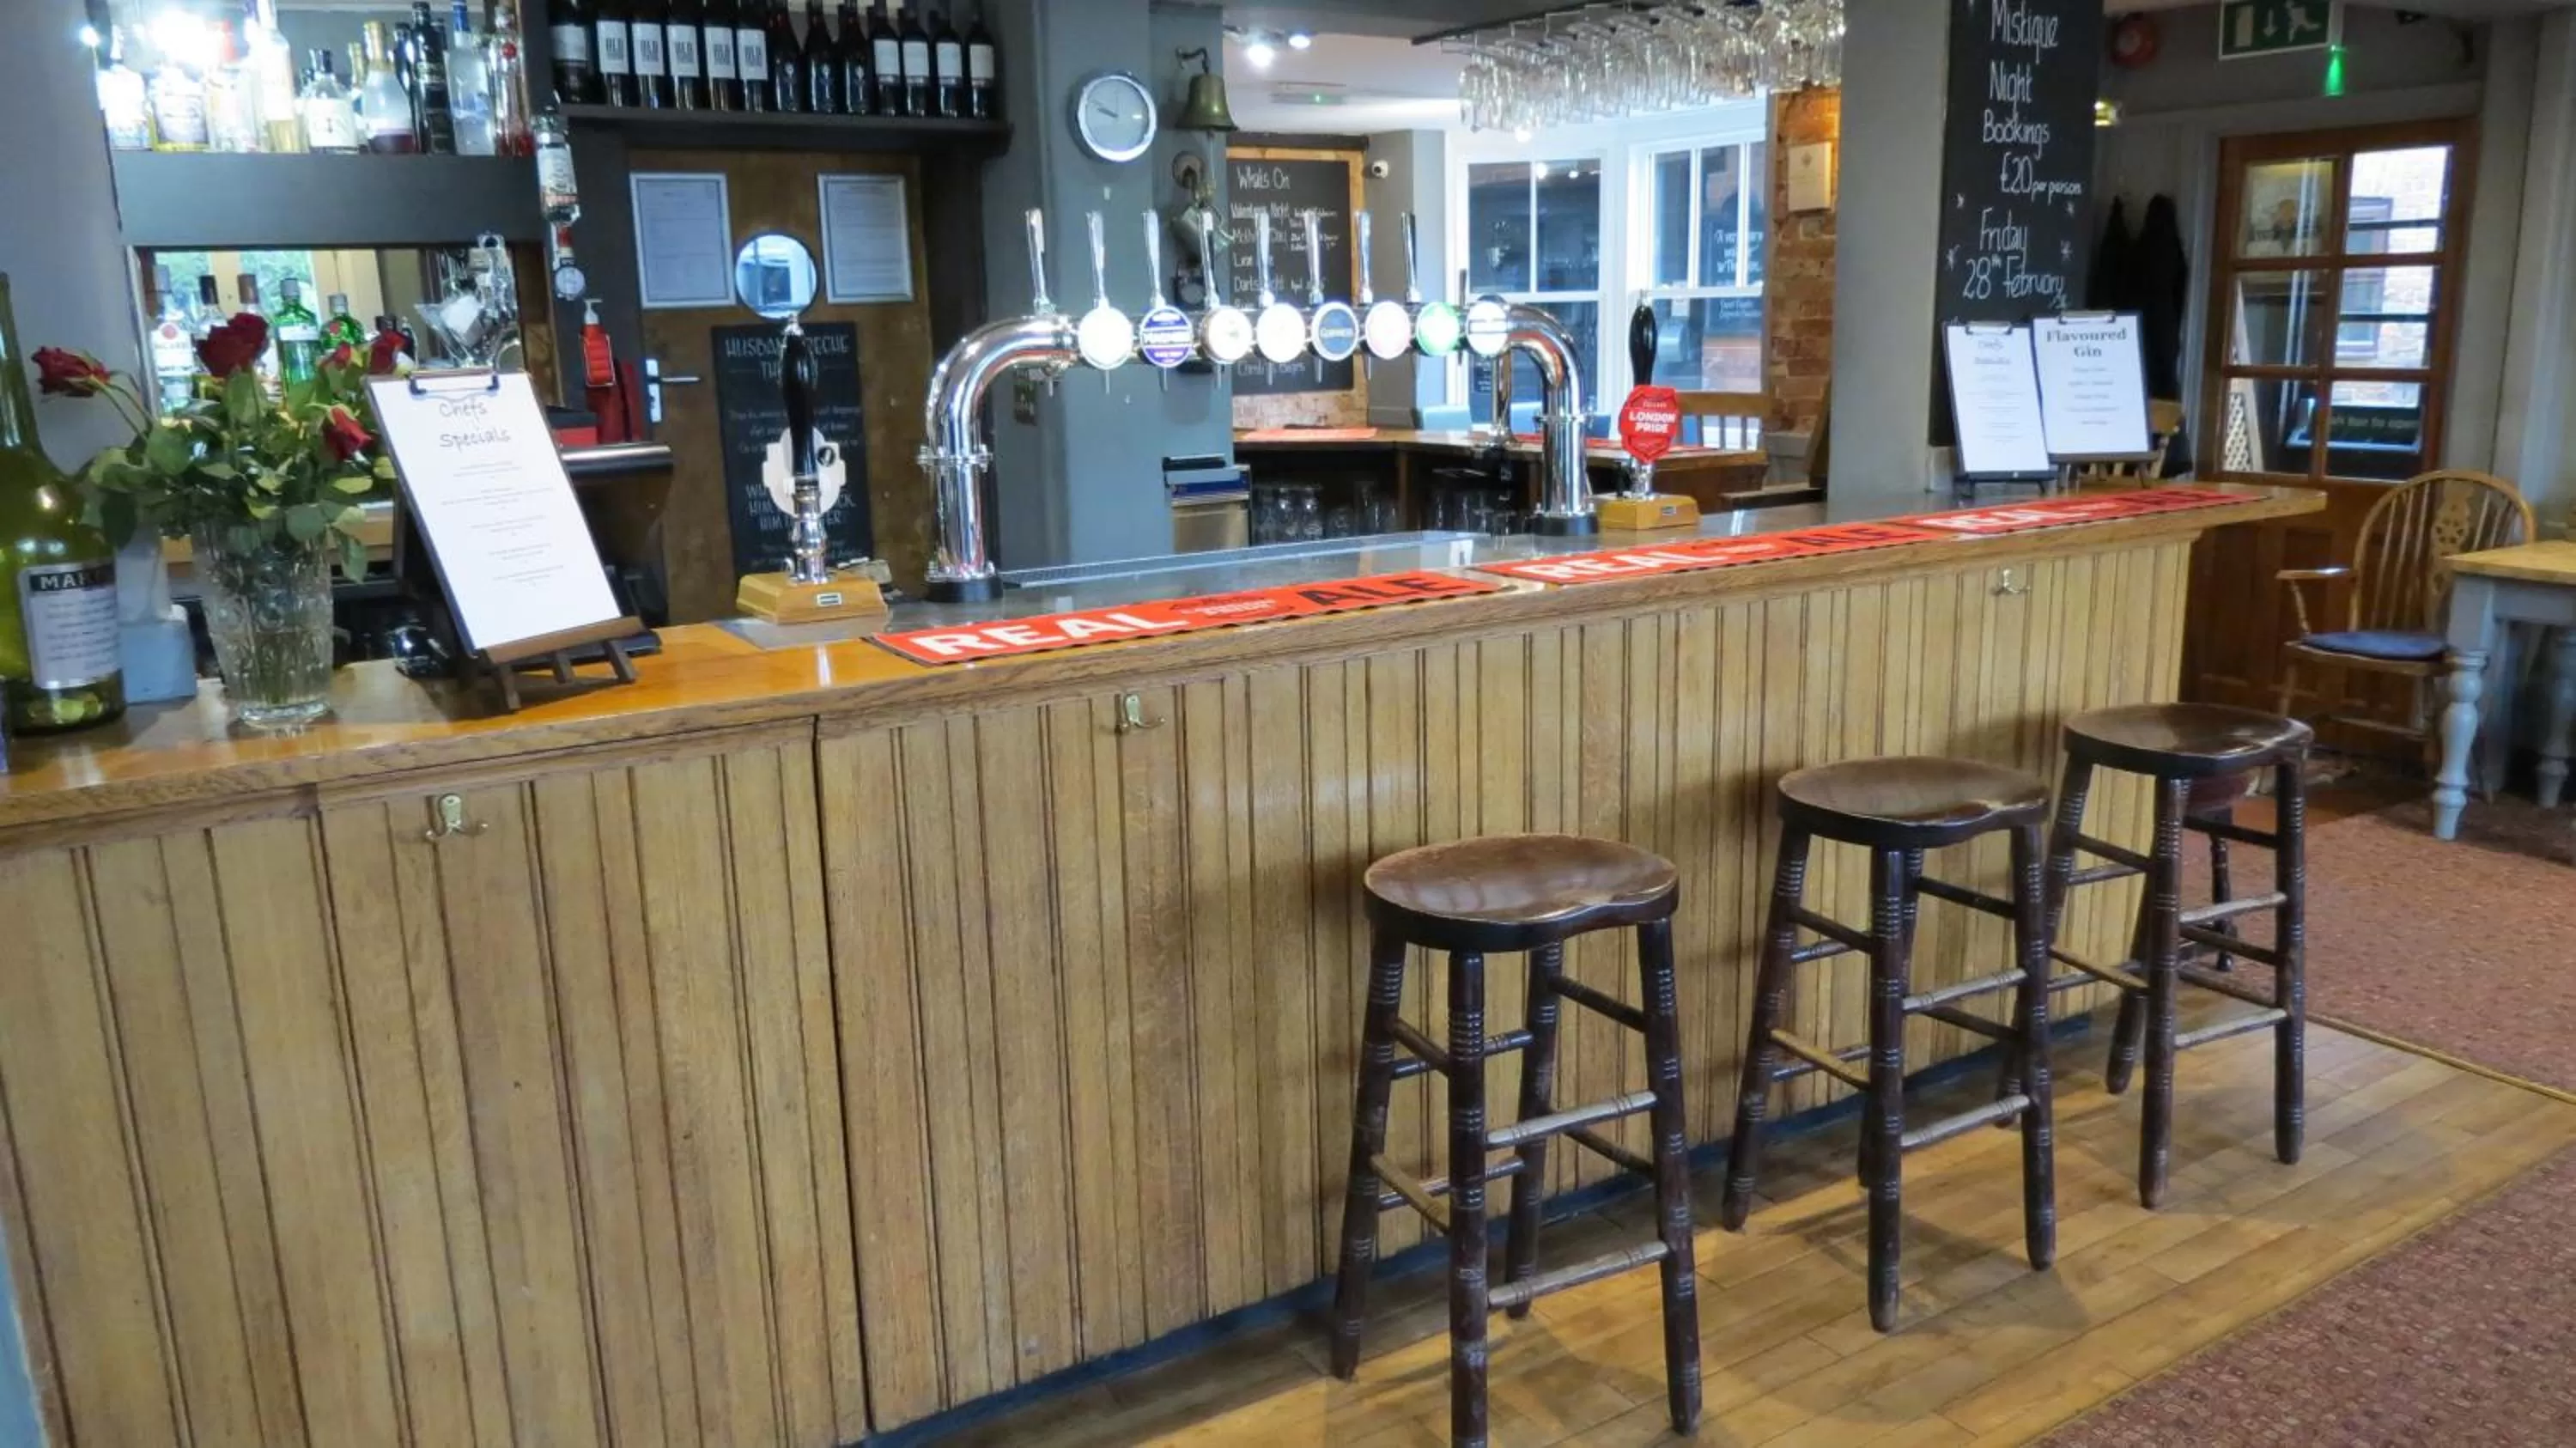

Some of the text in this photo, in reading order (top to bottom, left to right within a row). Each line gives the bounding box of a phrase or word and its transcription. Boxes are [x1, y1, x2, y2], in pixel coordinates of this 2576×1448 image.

[1988, 58, 2033, 123] Night
[1983, 108, 2051, 161] Bookings
[2000, 151, 2033, 193] £20
[1980, 206, 2028, 273] Friday
[2002, 255, 2065, 299] February
[2045, 327, 2128, 343] Flavoured
[2074, 346, 2103, 358] Gin
[1628, 411, 1677, 423] LONDON
[1634, 422, 1668, 434] PRIDE
[439, 429, 512, 453] Specials
[1511, 551, 1729, 579] REAL
[1297, 576, 1471, 605] ALE
[909, 612, 1190, 656] REAL
